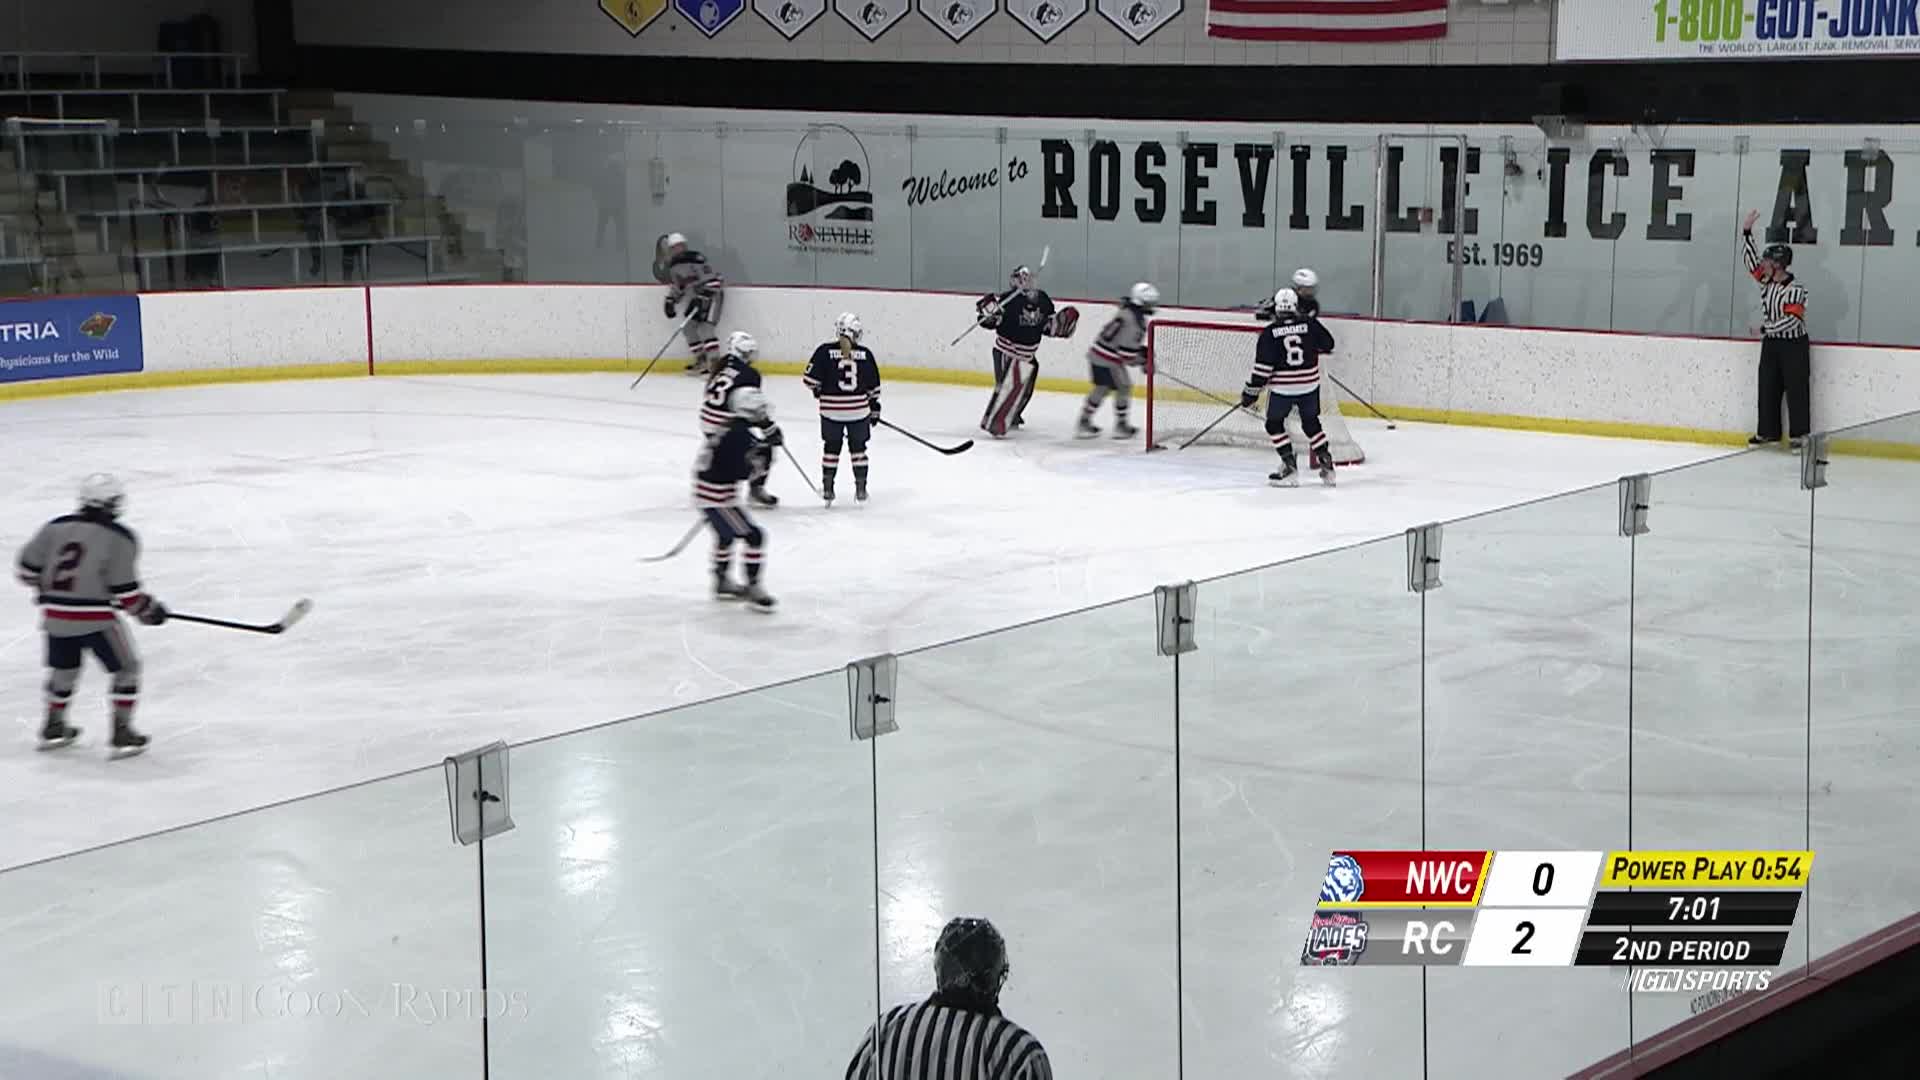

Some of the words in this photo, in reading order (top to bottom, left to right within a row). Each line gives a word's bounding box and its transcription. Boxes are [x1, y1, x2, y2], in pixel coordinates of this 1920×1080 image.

[1767, 41, 1809, 52] LARGEST
[1814, 40, 1836, 51] JUNK
[1841, 39, 1889, 50] REMOVAL
[902, 167, 998, 207] Welcome
[1007, 156, 1028, 182] to
[1040, 138, 1480, 234] ROSEVILLE
[1544, 146, 1696, 242] ICE
[1765, 148, 1920, 247] AR
[1446, 243, 1487, 265] Est.
[1493, 243, 1543, 267] 1969
[53, 352, 70, 364] for
[71, 350, 91, 363] the
[92, 348, 119, 361] Wild
[1283, 335, 1304, 366] 6
[838, 359, 857, 391] 3
[52, 542, 82, 592] 2
